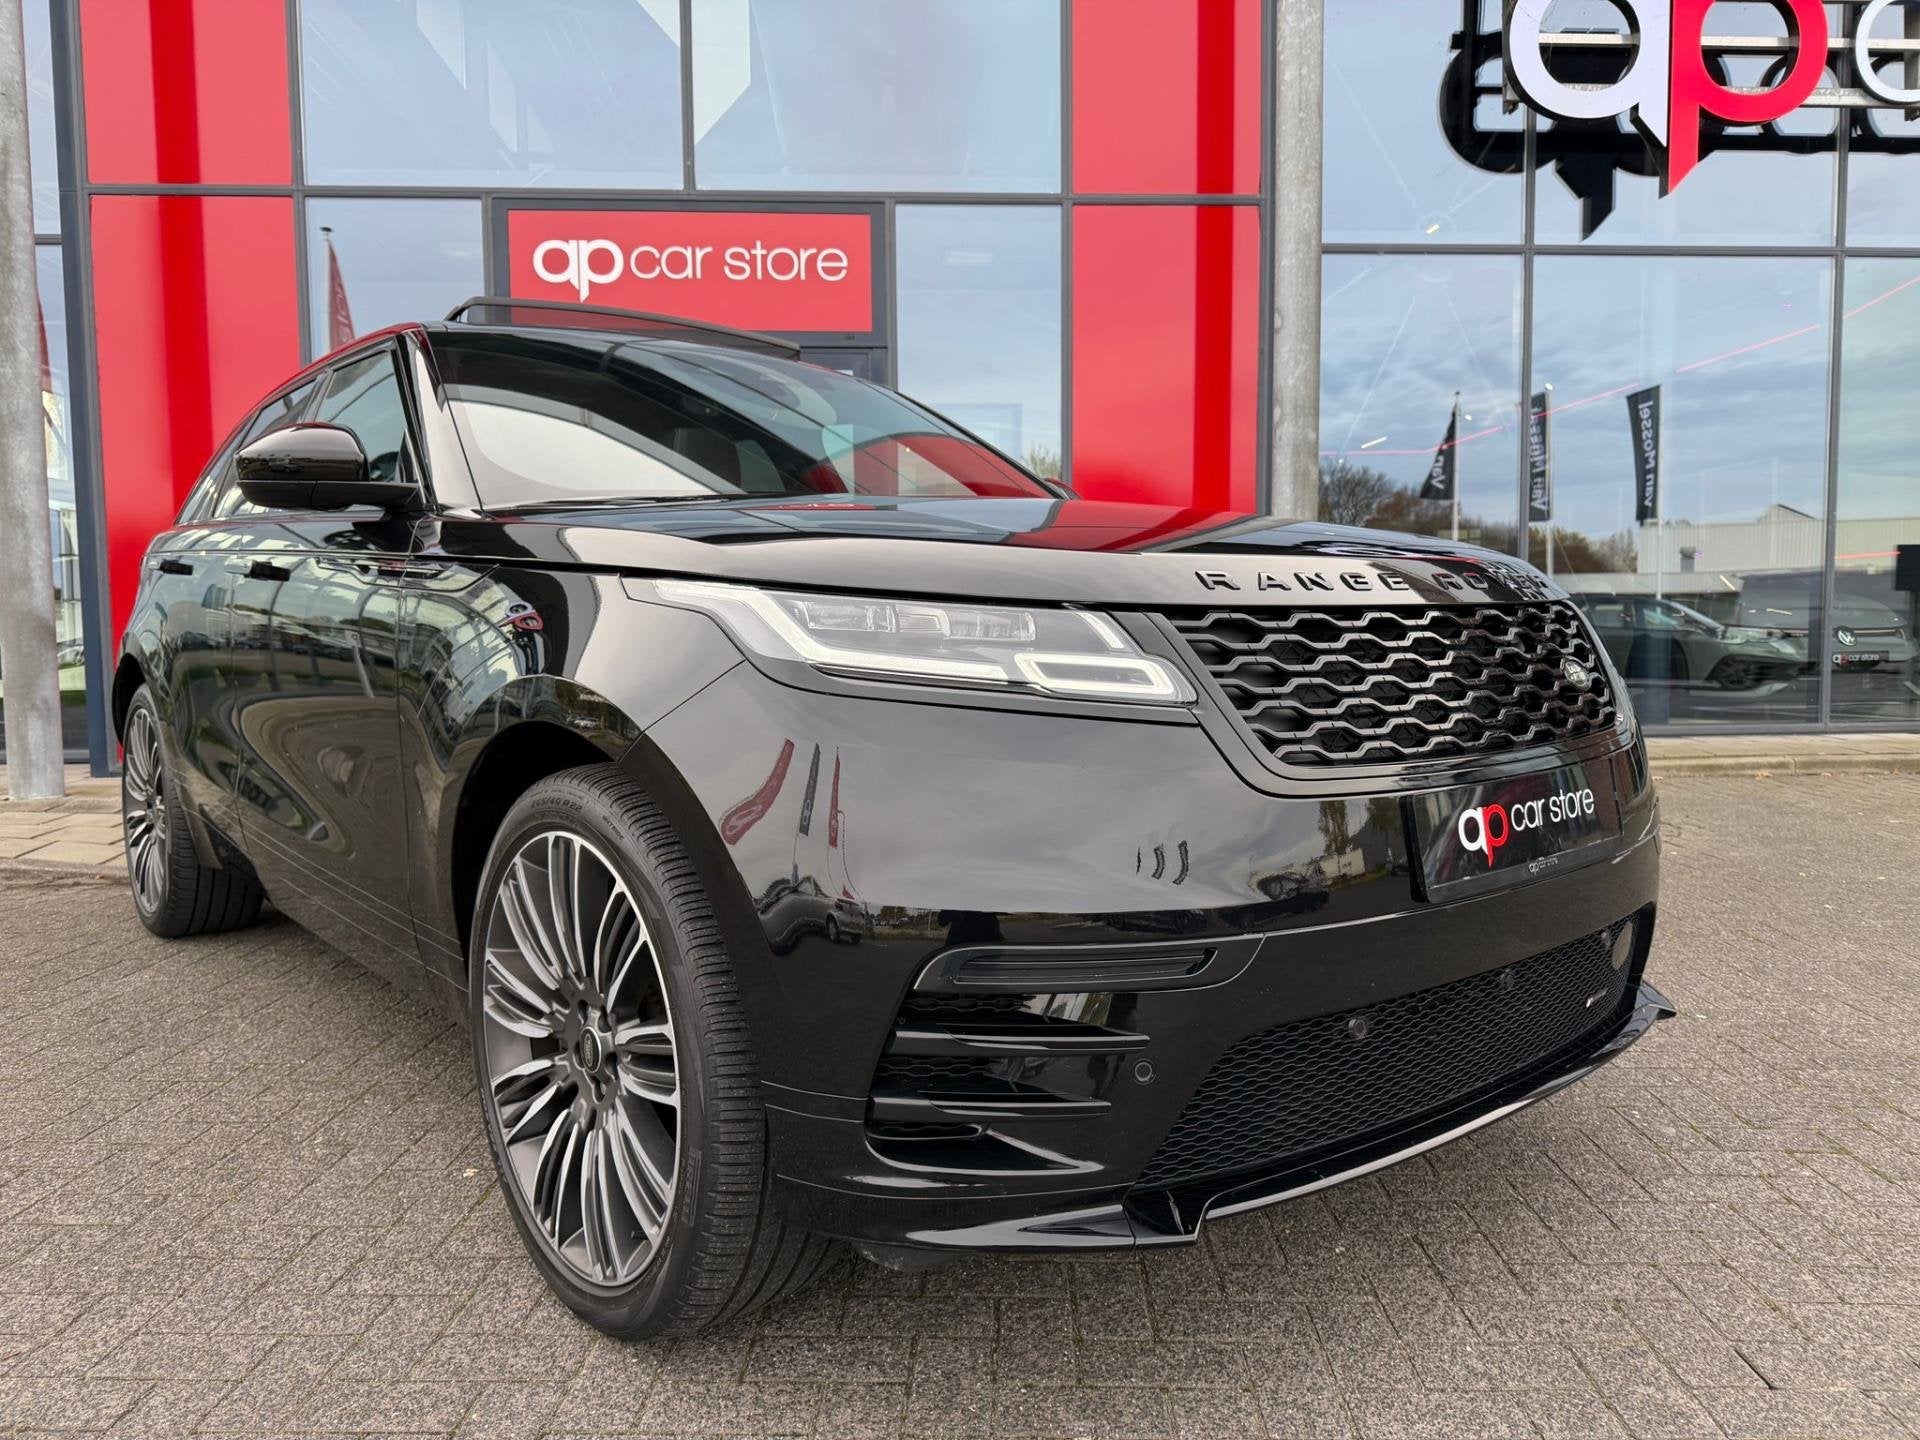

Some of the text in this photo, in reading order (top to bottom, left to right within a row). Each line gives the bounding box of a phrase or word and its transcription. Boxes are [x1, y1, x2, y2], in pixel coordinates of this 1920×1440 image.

[533, 239, 848, 303] ap car store
[1195, 570, 1410, 591] RANGE
[1458, 788, 1595, 868] ap car store
